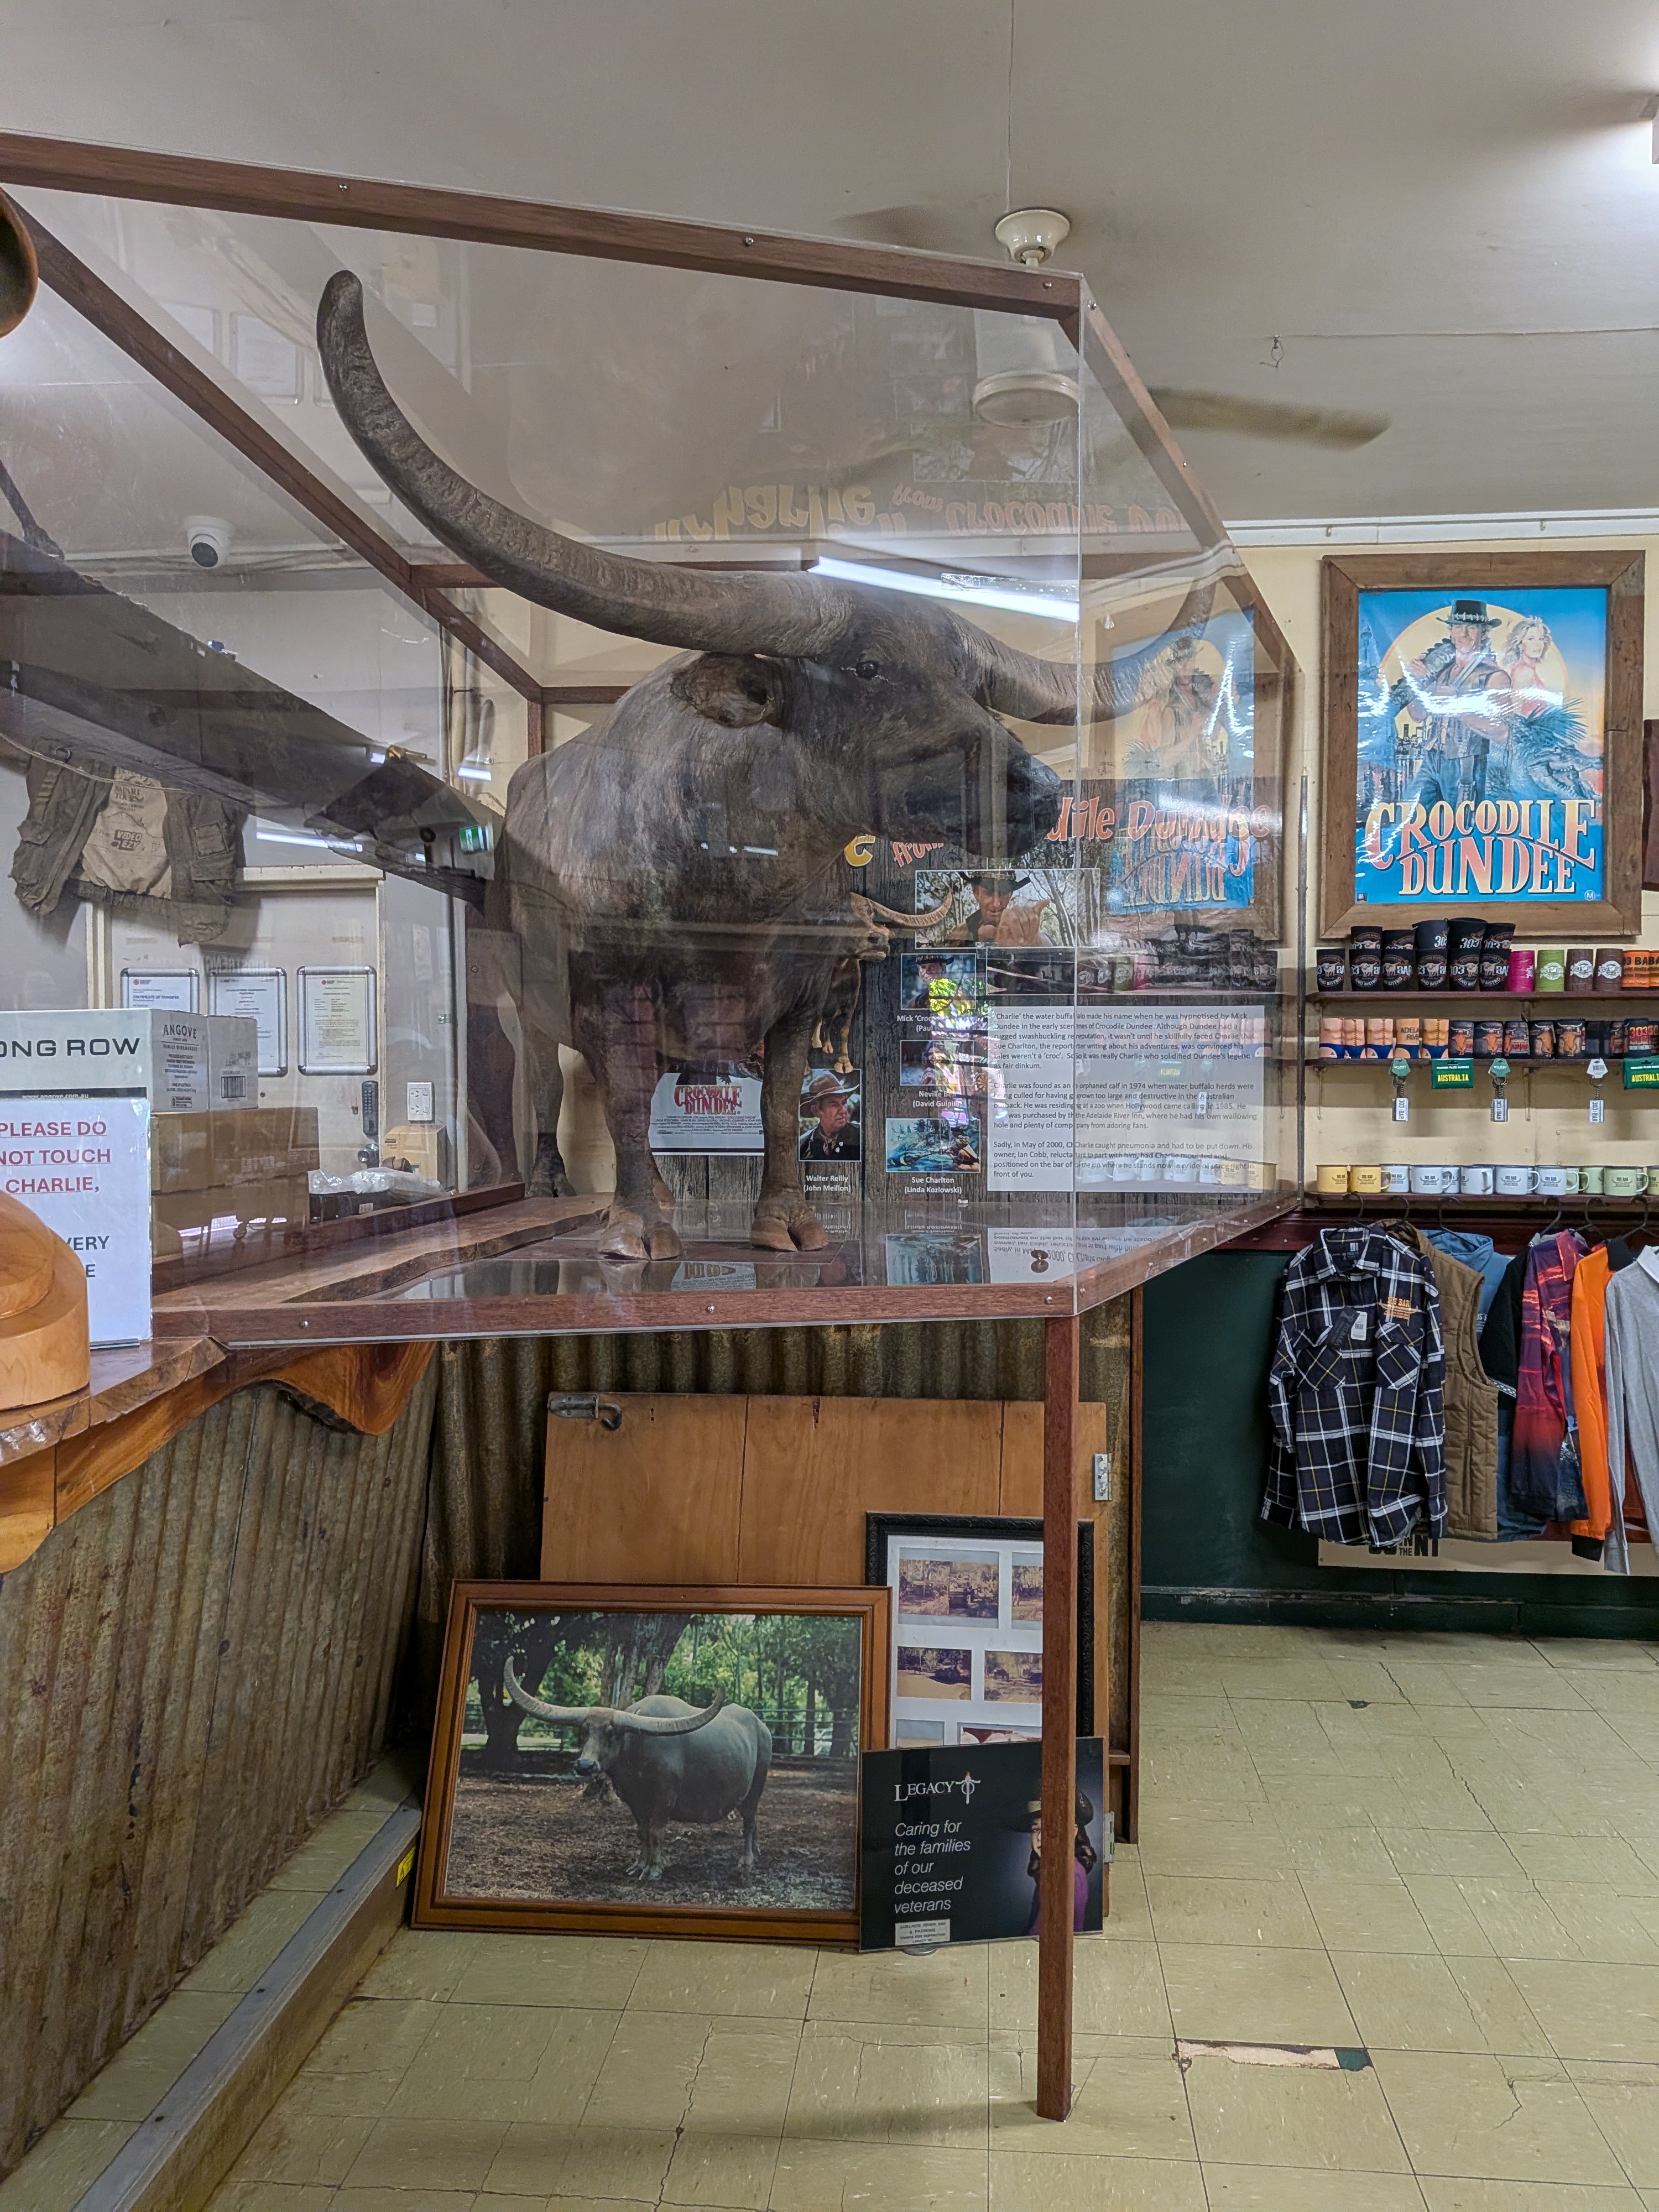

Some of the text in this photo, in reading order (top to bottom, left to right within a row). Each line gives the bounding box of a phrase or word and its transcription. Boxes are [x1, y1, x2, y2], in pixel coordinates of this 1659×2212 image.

[1128, 795, 1272, 841] Dundee
[117, 831, 142, 841] VIDEO
[1365, 800, 1595, 869] CROCODILE
[122, 841, 139, 849] EZY
[1399, 836, 1575, 894] DUNDEE
[163, 1025, 197, 1039] ANGOVE
[67, 1037, 140, 1056] ROW
[1079, 1082, 1107, 1091] orphaned
[674, 1086, 742, 1108] CROCODILE
[1046, 1092, 1067, 1100] having
[684, 1097, 737, 1115] DUNDEE
[1223, 1113, 1258, 1121] wallowing
[0, 1121, 107, 1136] PLEASE DO
[39, 1149, 110, 1164] TOUCH
[994, 1161, 1029, 1169] positioned
[6, 1176, 99, 1193] CHARLIE,
[830, 1175, 848, 1183] Reilly
[1400, 1548, 1412, 1556] THE
[894, 1781, 955, 1802] LEGACY
[895, 1820, 962, 1838] Caring for
[895, 1839, 971, 1856] the families
[894, 1861, 935, 1875] of our
[894, 1876, 963, 1895] deceased
[894, 1899, 952, 1914] veterans
